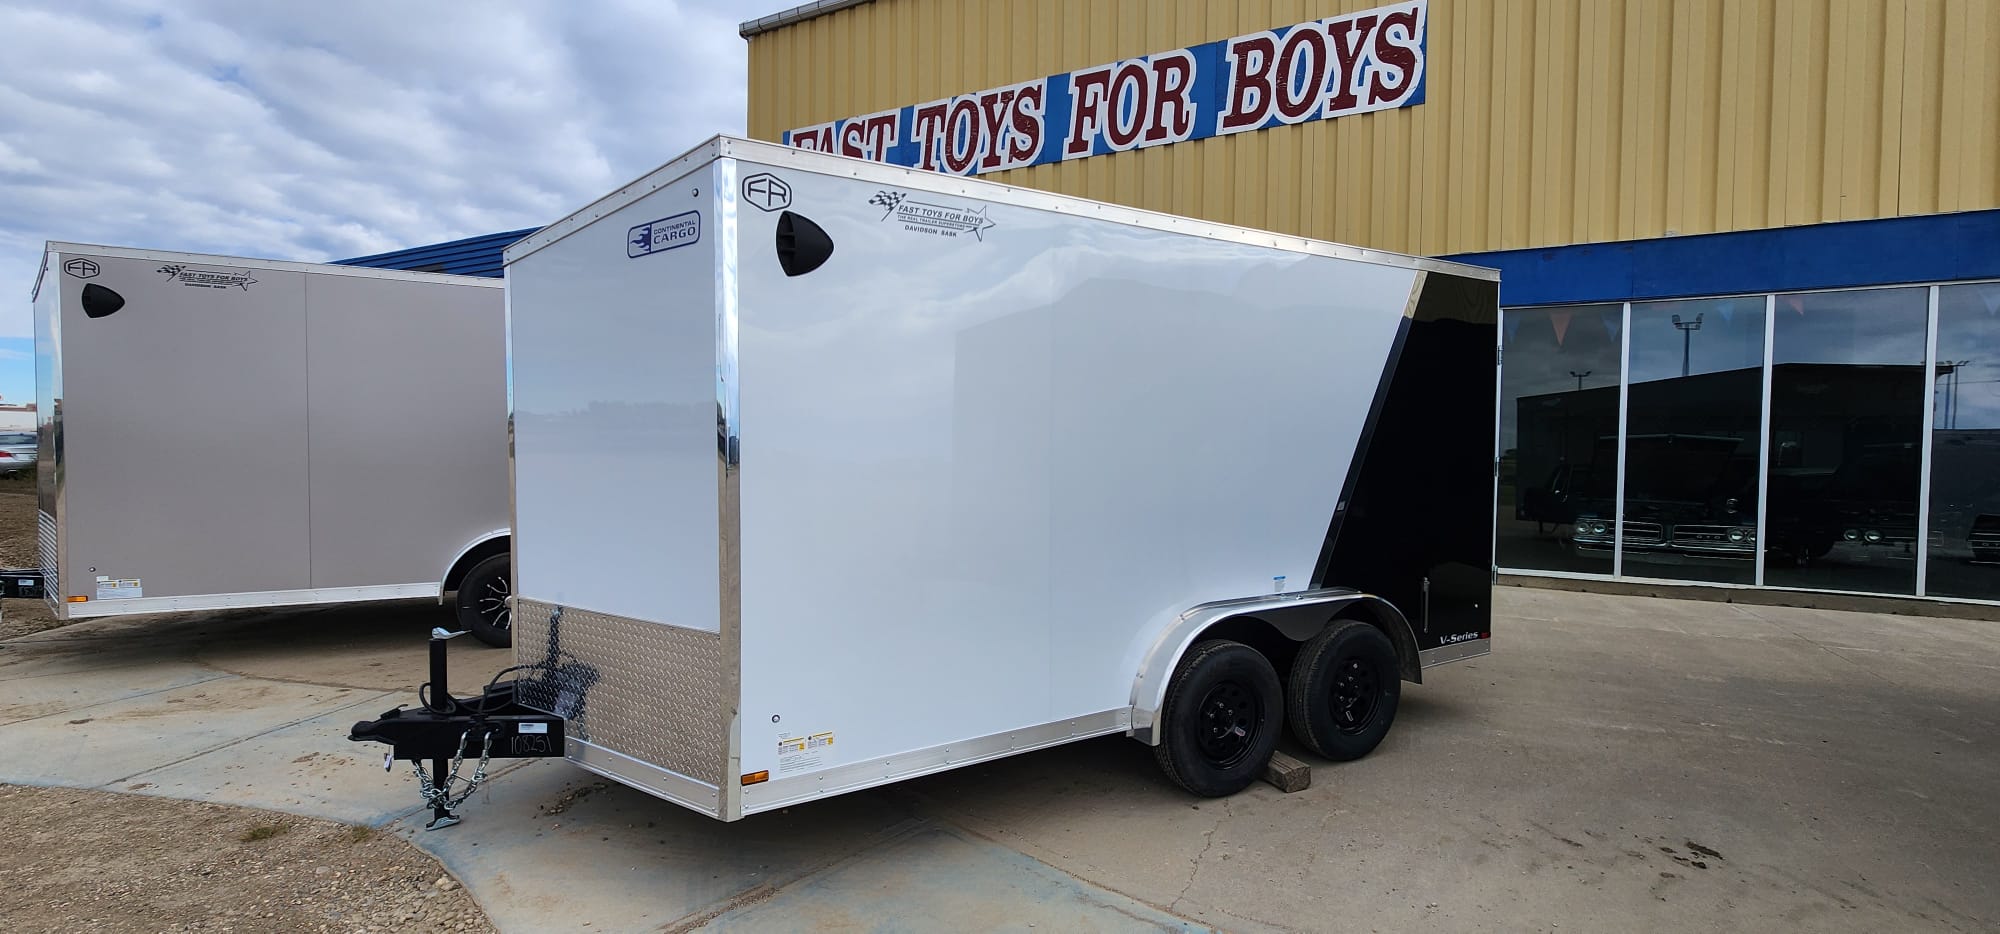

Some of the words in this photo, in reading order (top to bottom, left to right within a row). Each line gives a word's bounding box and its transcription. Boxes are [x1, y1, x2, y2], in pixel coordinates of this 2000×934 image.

[914, 78, 1043, 172] TOYS
[1068, 55, 1190, 154] FOR
[1222, 7, 1418, 128] BOYS
[747, 178, 787, 207] FR
[898, 204, 919, 214] FAST
[922, 208, 943, 218] TOYS
[944, 211, 961, 221] FOR
[962, 214, 984, 225] BOYS
[653, 219, 696, 235] CONTINENTAL
[653, 226, 696, 245] CARGO
[904, 224, 938, 234] DAVIDSON
[940, 229, 957, 238] SASK
[179, 271, 196, 279] FAST
[198, 272, 215, 280] TOYS
[1440, 631, 1479, 645] V-Series
[511, 735, 553, 755] 108251
